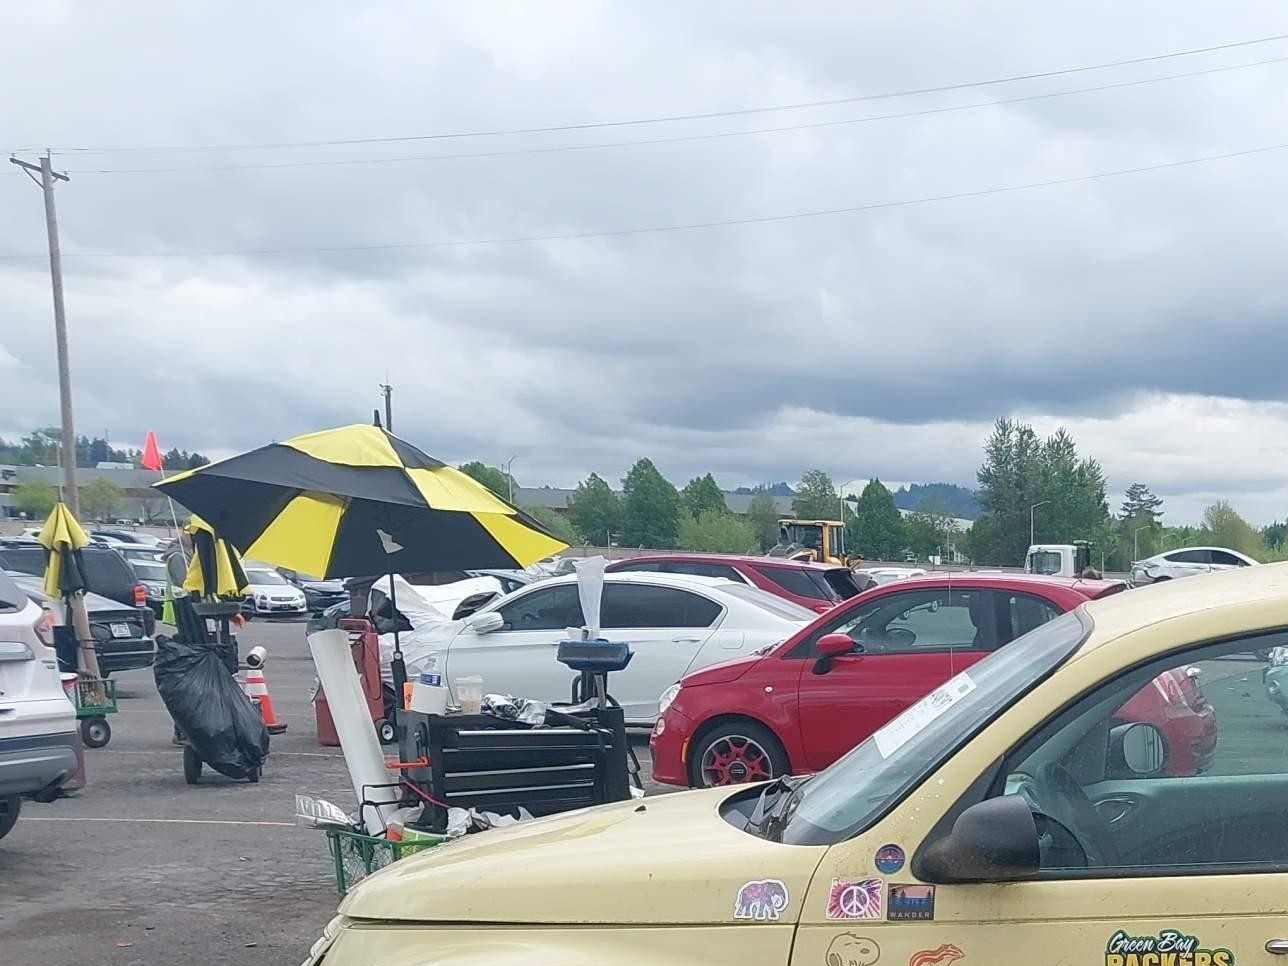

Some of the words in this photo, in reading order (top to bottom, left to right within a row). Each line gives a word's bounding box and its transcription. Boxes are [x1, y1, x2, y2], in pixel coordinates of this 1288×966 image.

[889, 911, 931, 919] WANDER
[1109, 932, 1154, 953] Green
[1157, 932, 1196, 958] Bay
